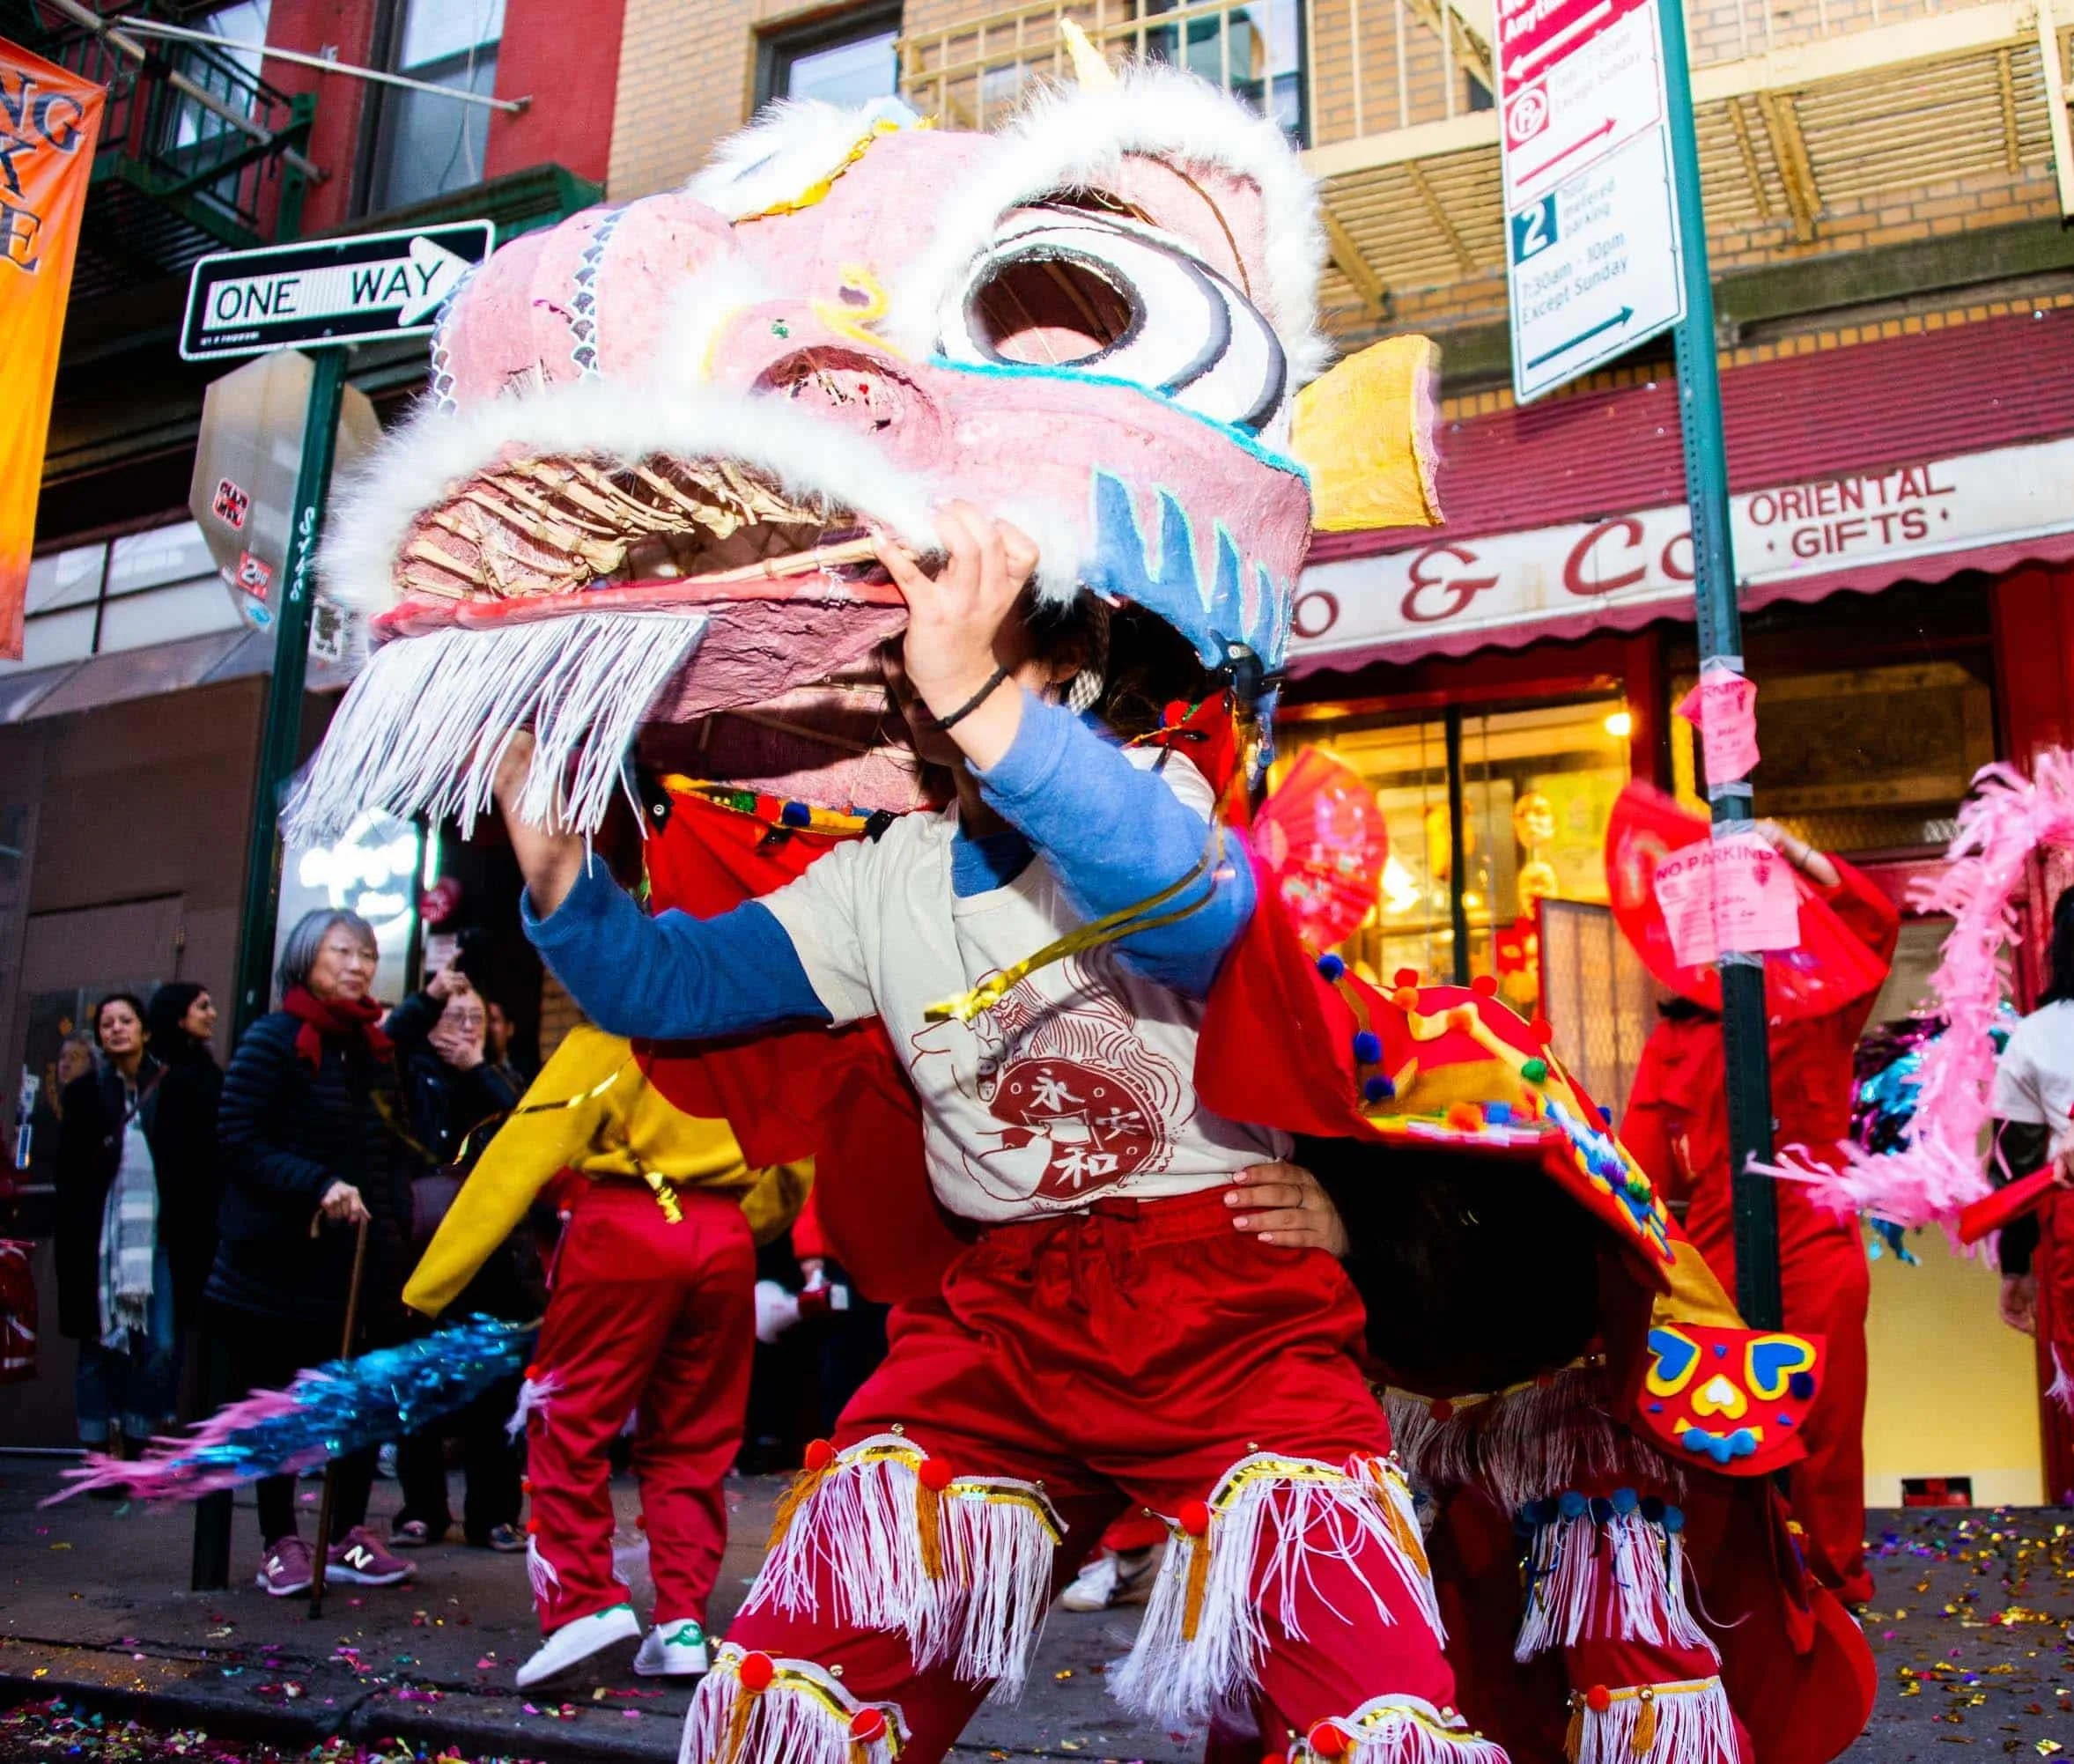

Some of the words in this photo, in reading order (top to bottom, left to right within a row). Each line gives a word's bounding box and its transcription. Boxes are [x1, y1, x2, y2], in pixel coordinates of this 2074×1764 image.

[1521, 200, 1547, 257] 2
[1587, 232, 1627, 262] 10pm
[217, 278, 300, 321] ONE
[351, 260, 444, 306] WAY
[1523, 285, 1570, 325] Except
[1575, 255, 1628, 296] Sunday
[1749, 466, 1956, 526] ORIENTAL
[1791, 508, 1929, 558] GIFTS
[1401, 543, 1500, 622] &
[1657, 862, 1682, 881] NO
[1031, 1068, 1085, 1112] 永
[1052, 1147, 1119, 1189] 和
[344, 1545, 374, 1569] N
